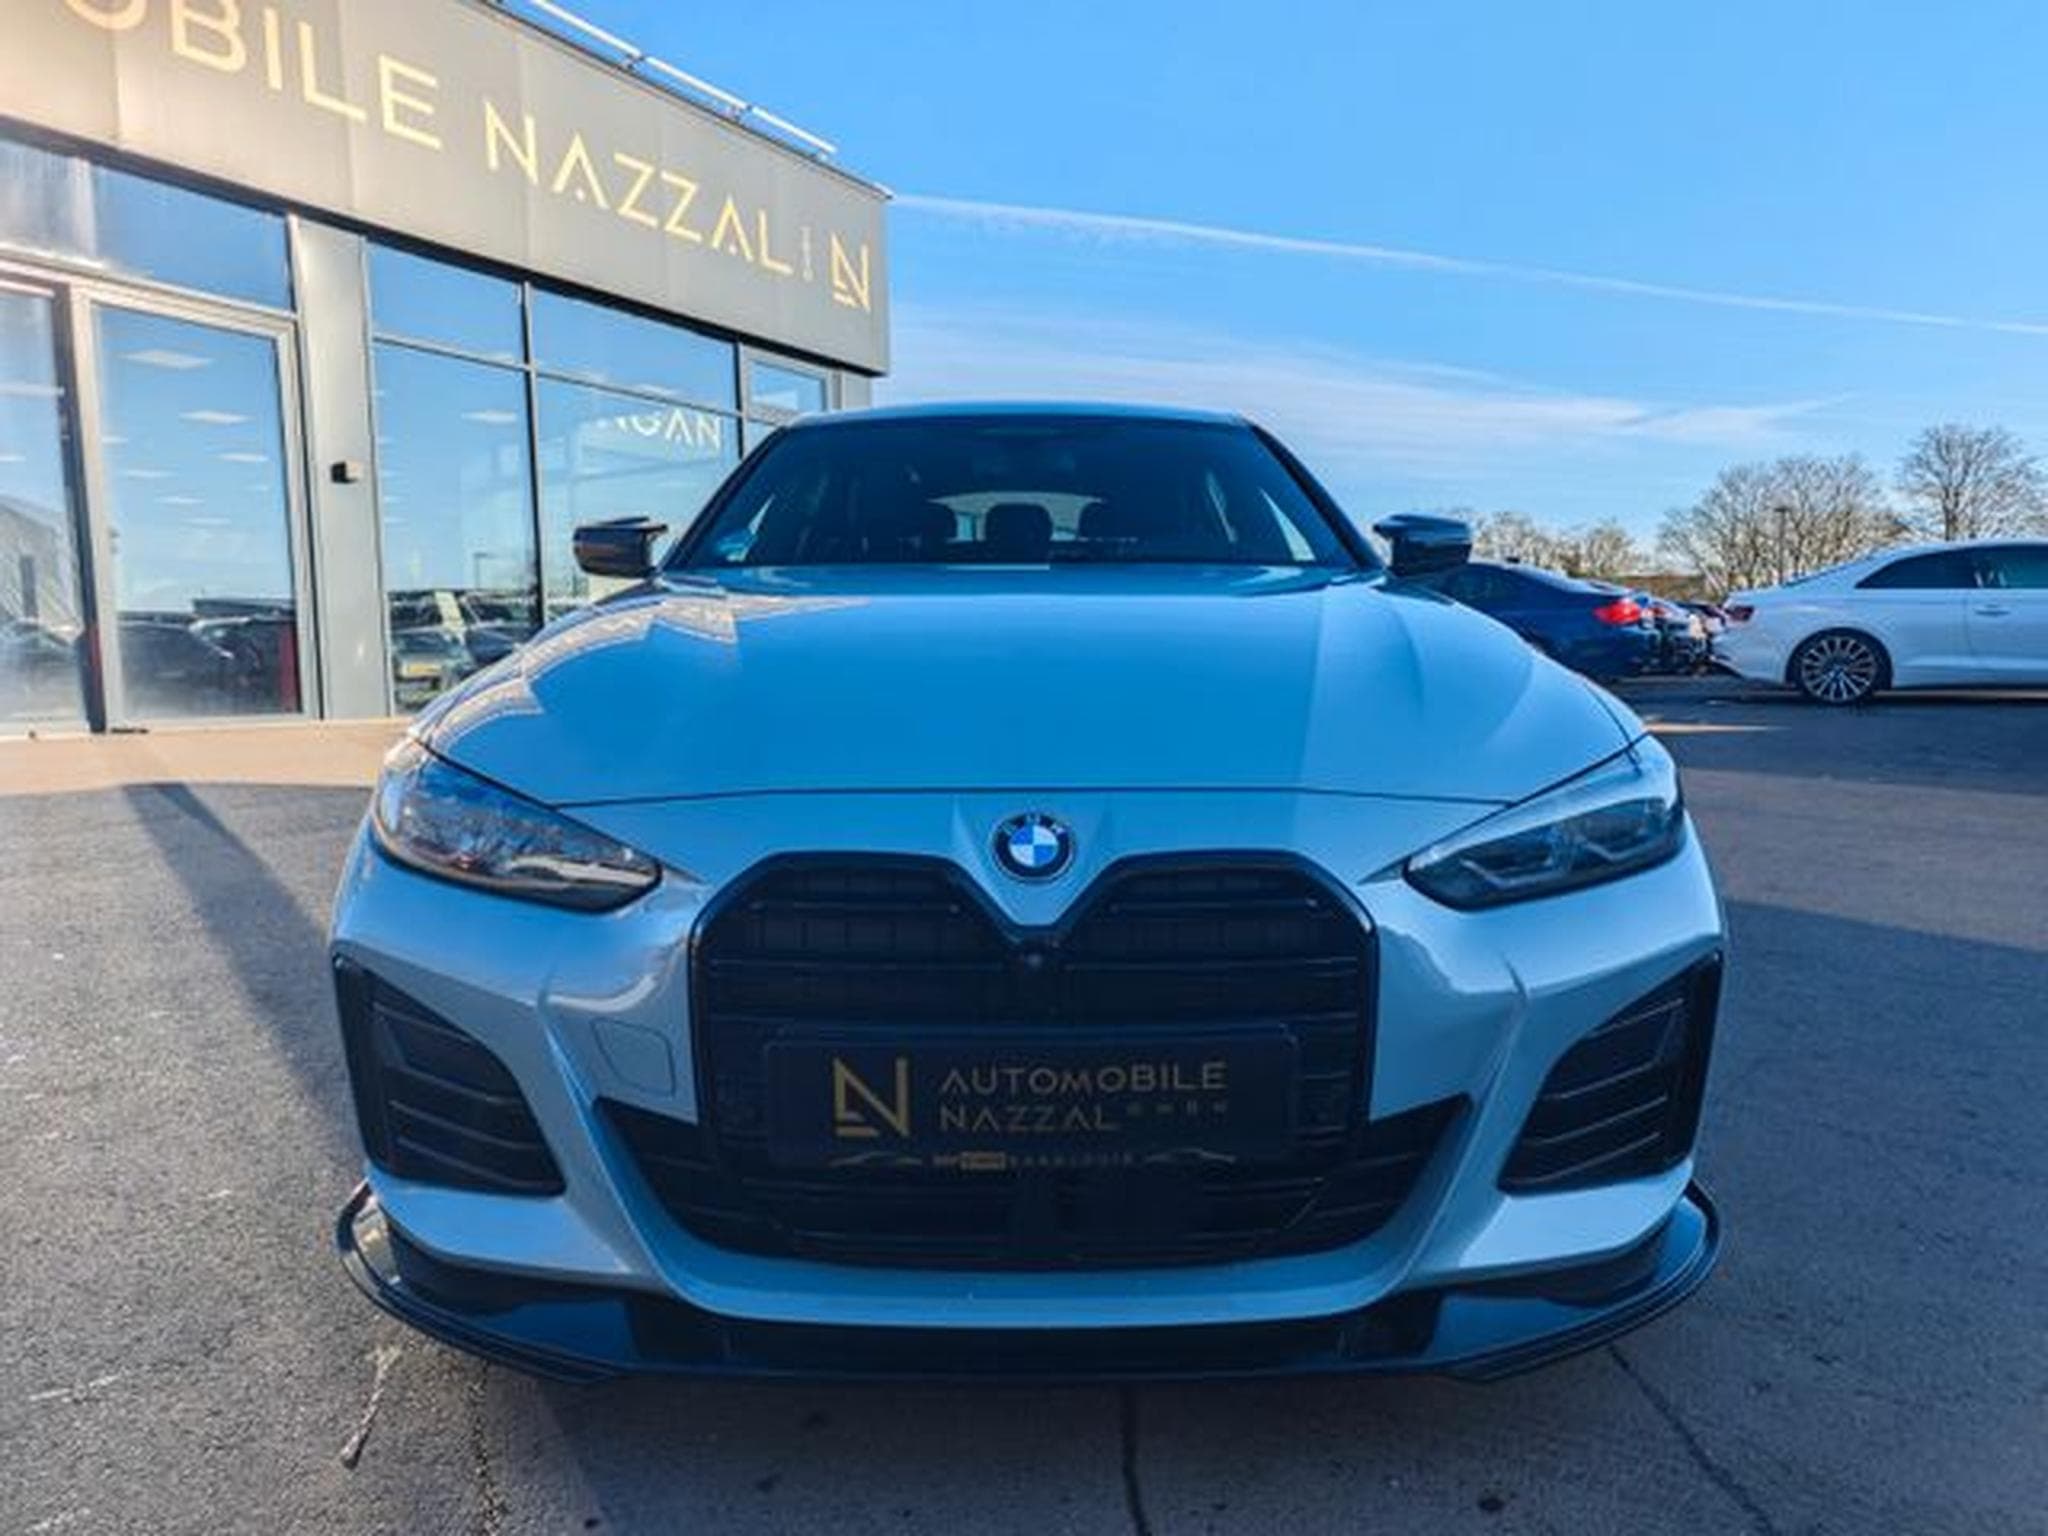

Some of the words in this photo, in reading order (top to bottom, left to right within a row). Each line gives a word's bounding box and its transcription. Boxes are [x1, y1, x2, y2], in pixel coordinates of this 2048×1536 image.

[484, 100, 794, 276] NAZZAL
[939, 1061, 1229, 1094] AUTOMOBILE
[939, 1104, 1119, 1133] NAZZAL
